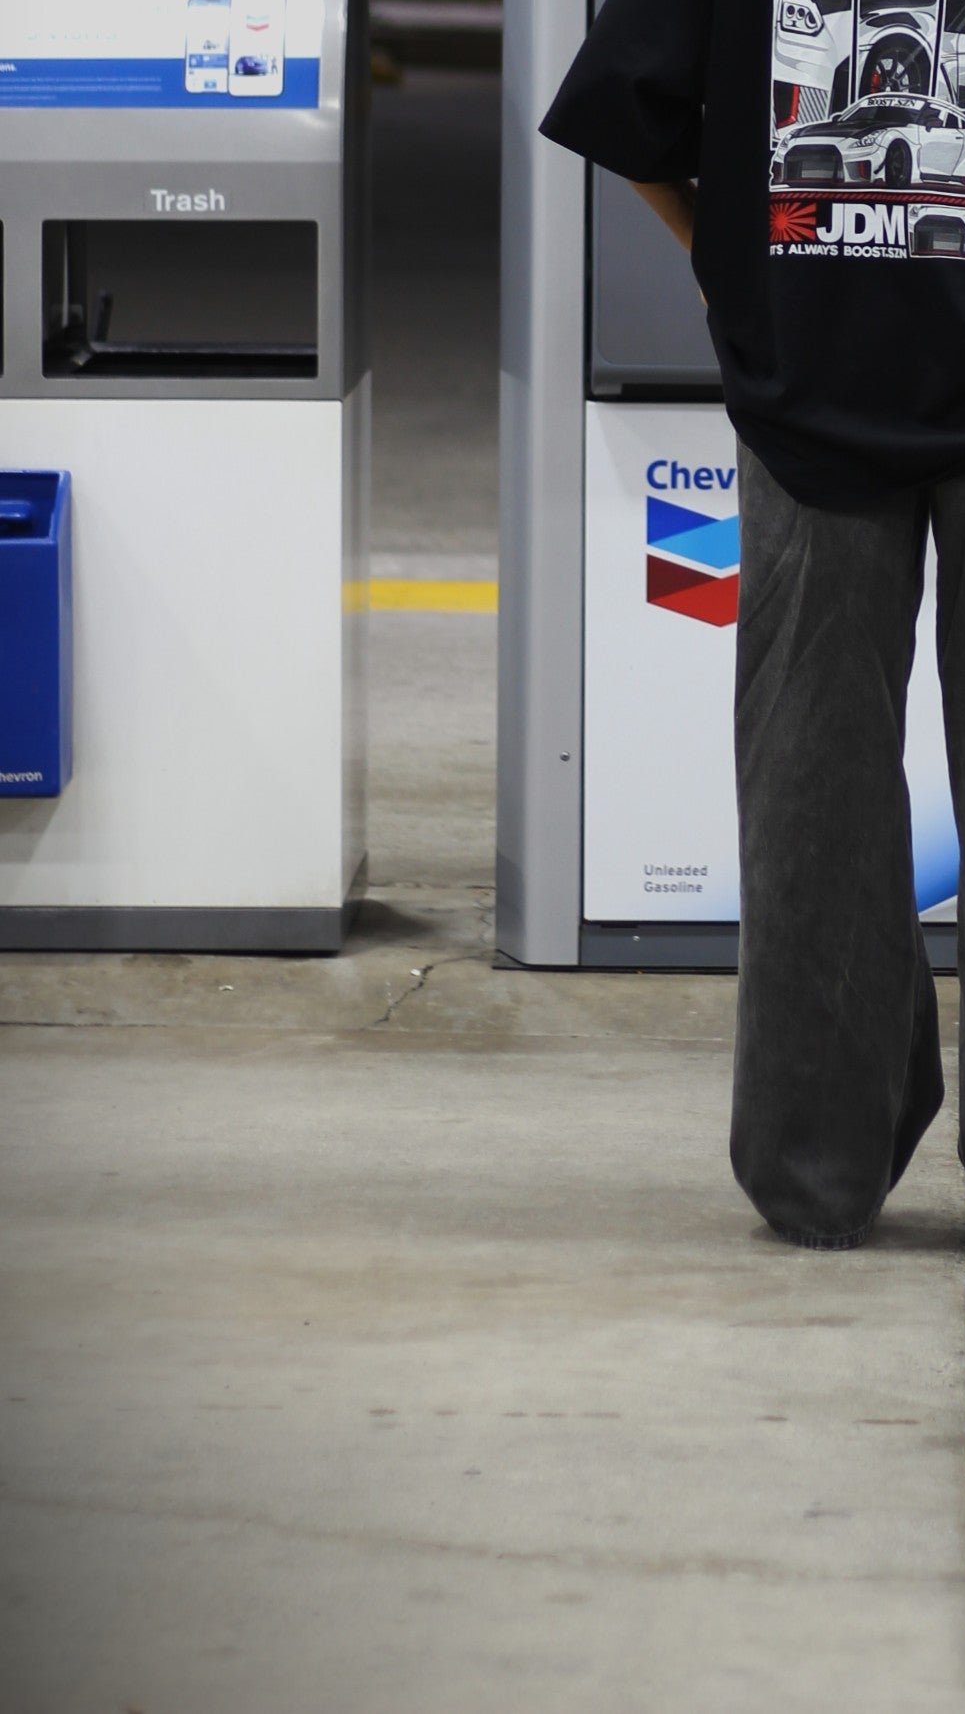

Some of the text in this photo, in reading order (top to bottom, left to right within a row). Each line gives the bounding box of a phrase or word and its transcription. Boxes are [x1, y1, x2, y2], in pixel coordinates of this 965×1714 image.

[151, 189, 226, 211] Trash
[816, 203, 906, 245] JDM
[788, 244, 839, 256] ALWAYS
[843, 245, 907, 259] BOOST.SZN
[646, 459, 737, 490] Chev
[0, 772, 43, 782] hevron
[643, 864, 708, 876] Unleaded
[643, 881, 703, 893] Gasoline
